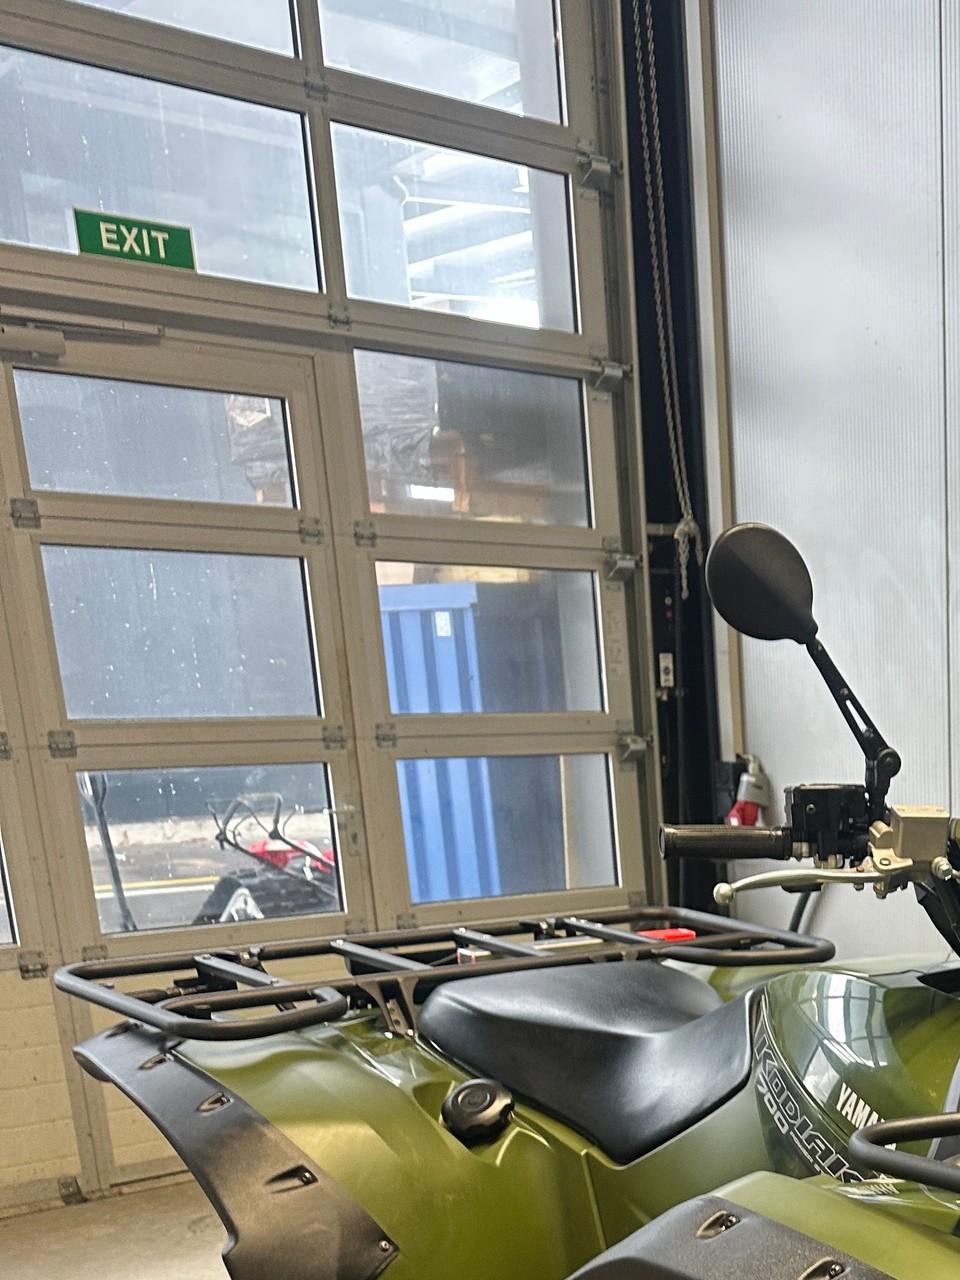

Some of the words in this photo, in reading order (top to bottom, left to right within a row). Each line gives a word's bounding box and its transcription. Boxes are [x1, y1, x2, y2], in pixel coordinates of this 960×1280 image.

[99, 220, 169, 258] EXIT
[755, 1033, 865, 1183] KODIAK
[757, 1073, 789, 1135] 700
